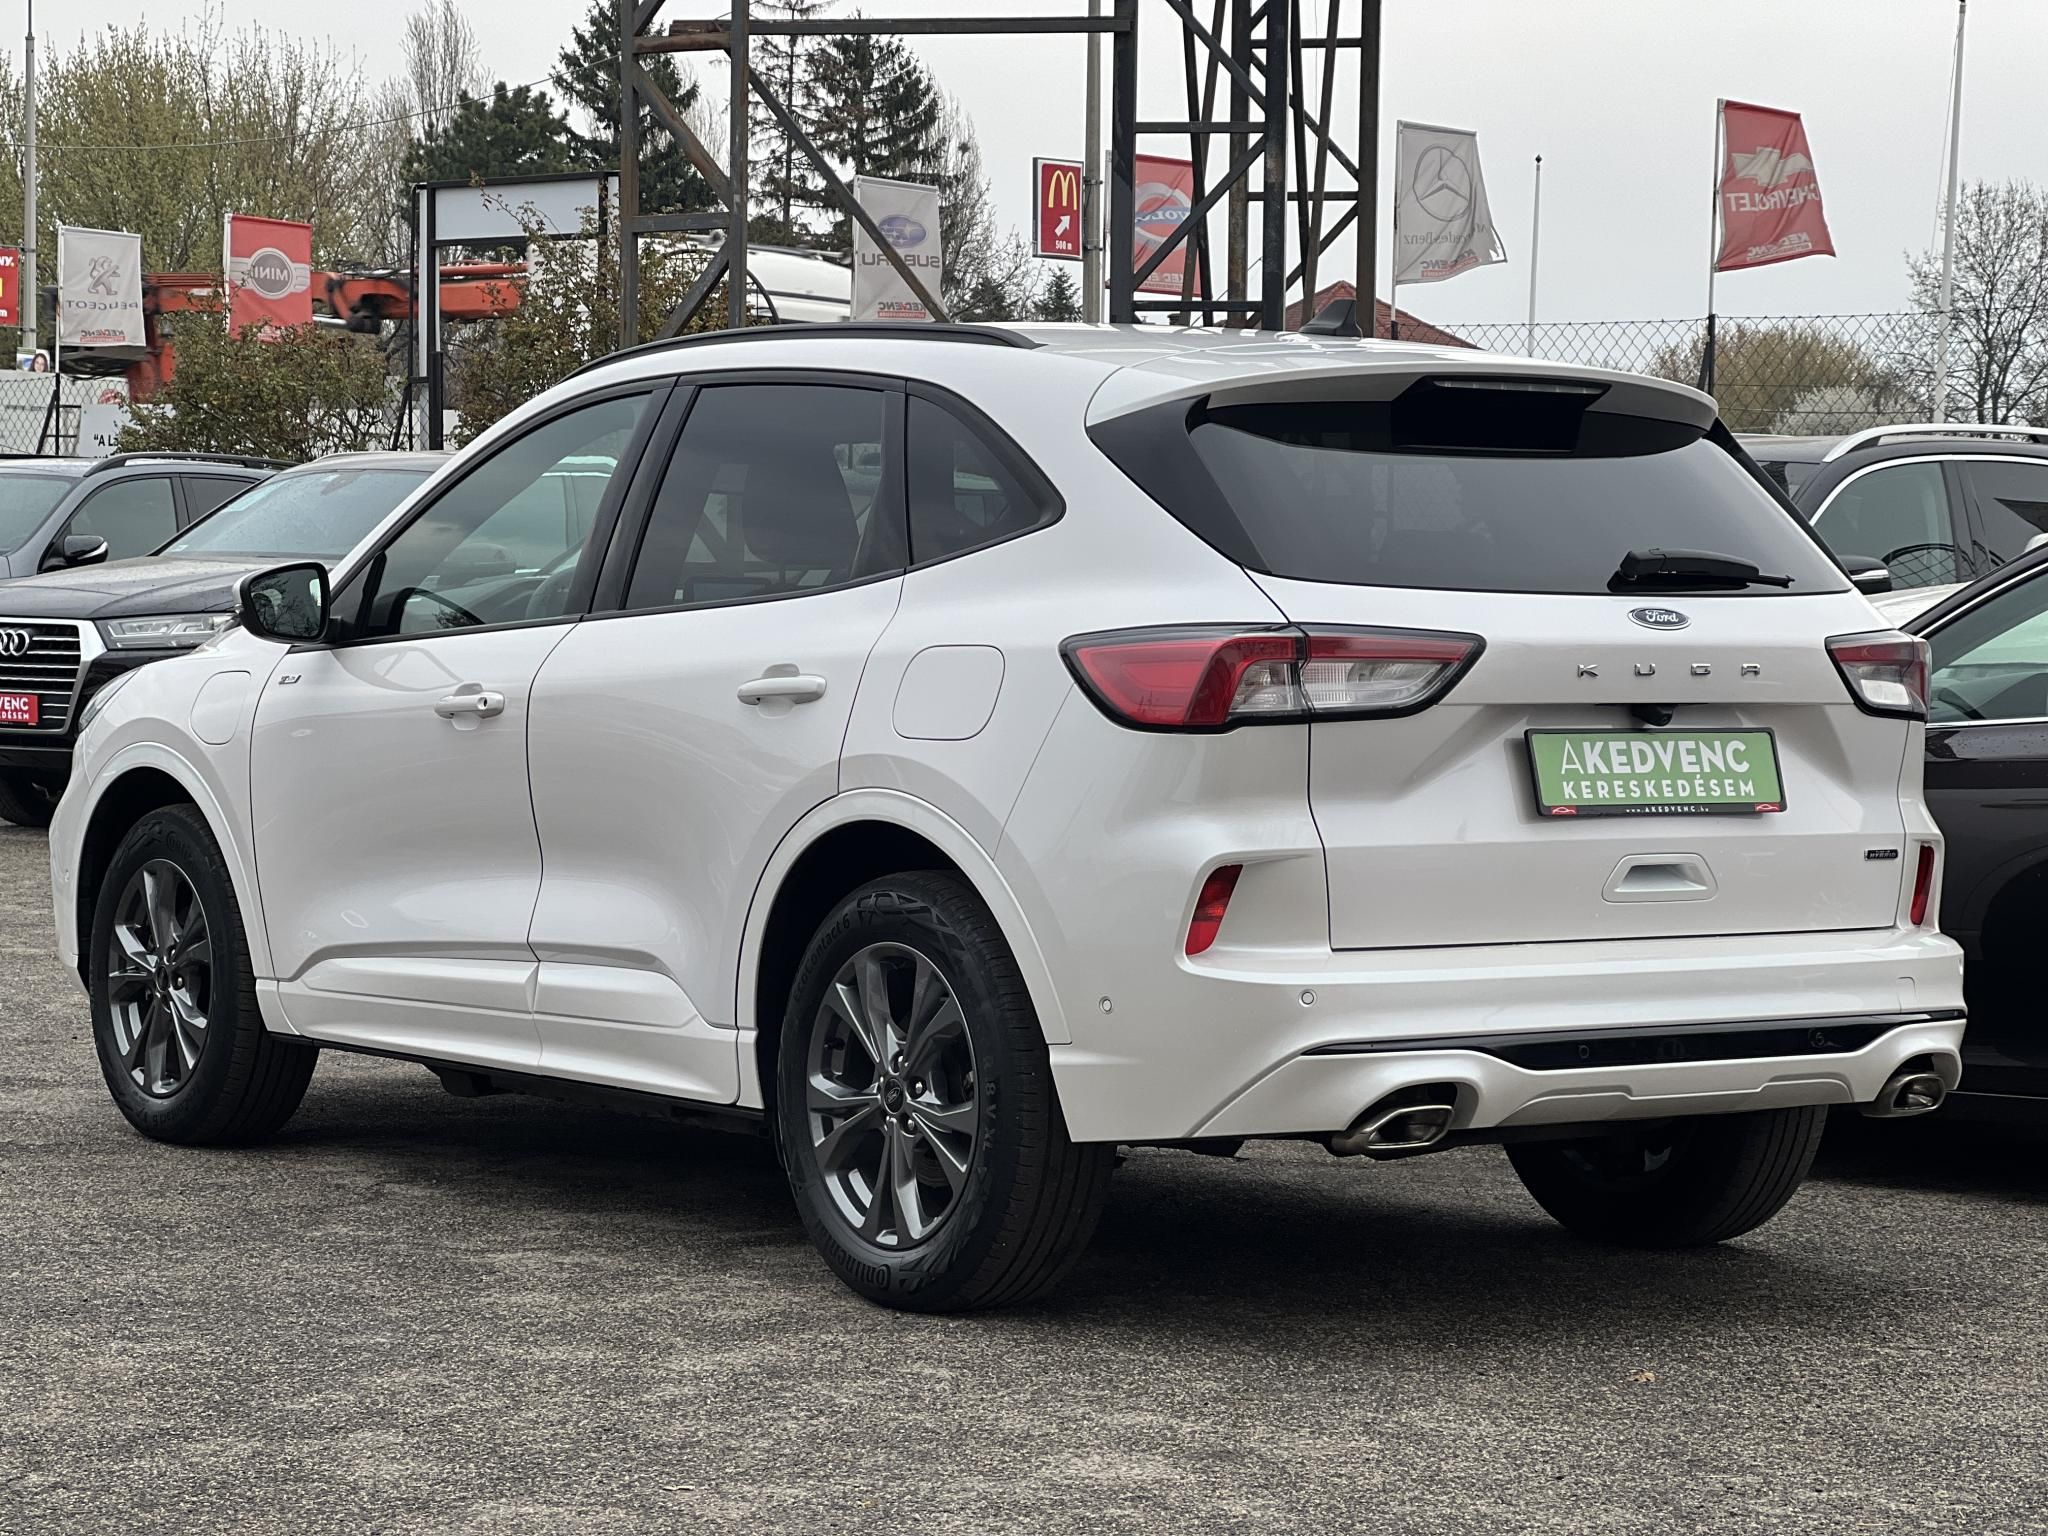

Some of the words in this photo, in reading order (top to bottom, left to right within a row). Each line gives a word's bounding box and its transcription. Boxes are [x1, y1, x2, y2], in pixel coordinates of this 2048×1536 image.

[1055, 240, 1066, 250] 500
[1645, 610, 1679, 622] Ford
[1576, 662, 1761, 679] KUGA
[1562, 775, 1755, 799] KERESKEDÉSEM
